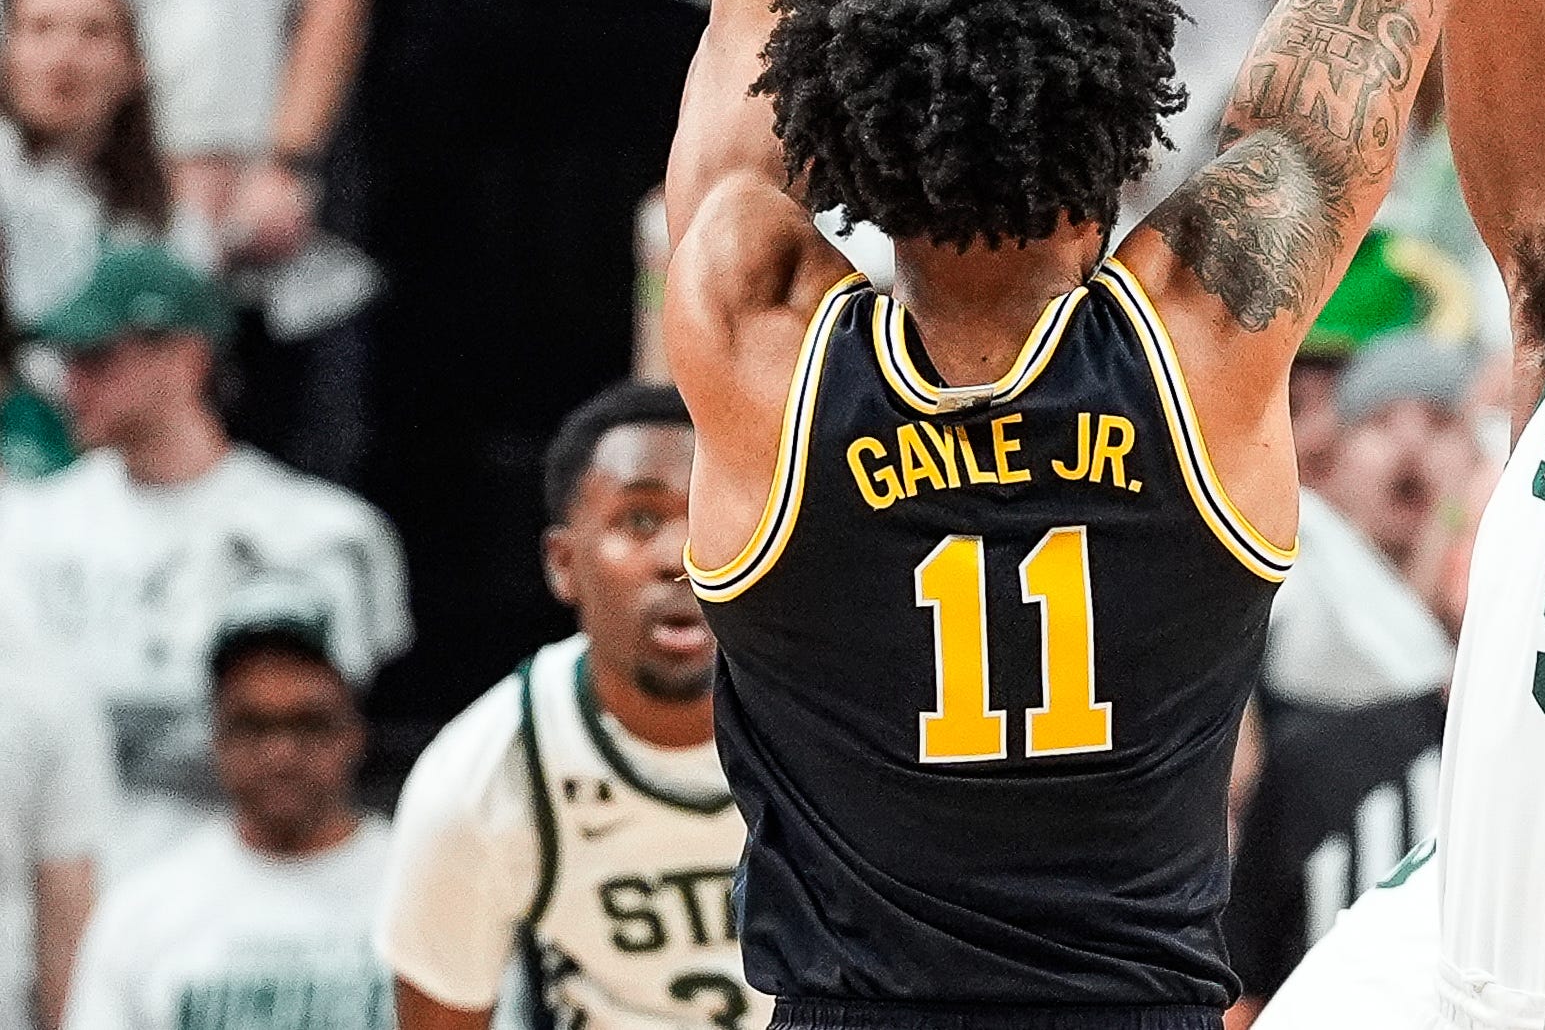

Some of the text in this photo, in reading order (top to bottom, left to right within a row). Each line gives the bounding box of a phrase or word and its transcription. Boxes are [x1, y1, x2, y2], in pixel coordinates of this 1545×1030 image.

[846, 412, 1143, 512] GAYLE JR.
[914, 525, 1113, 764] 11
